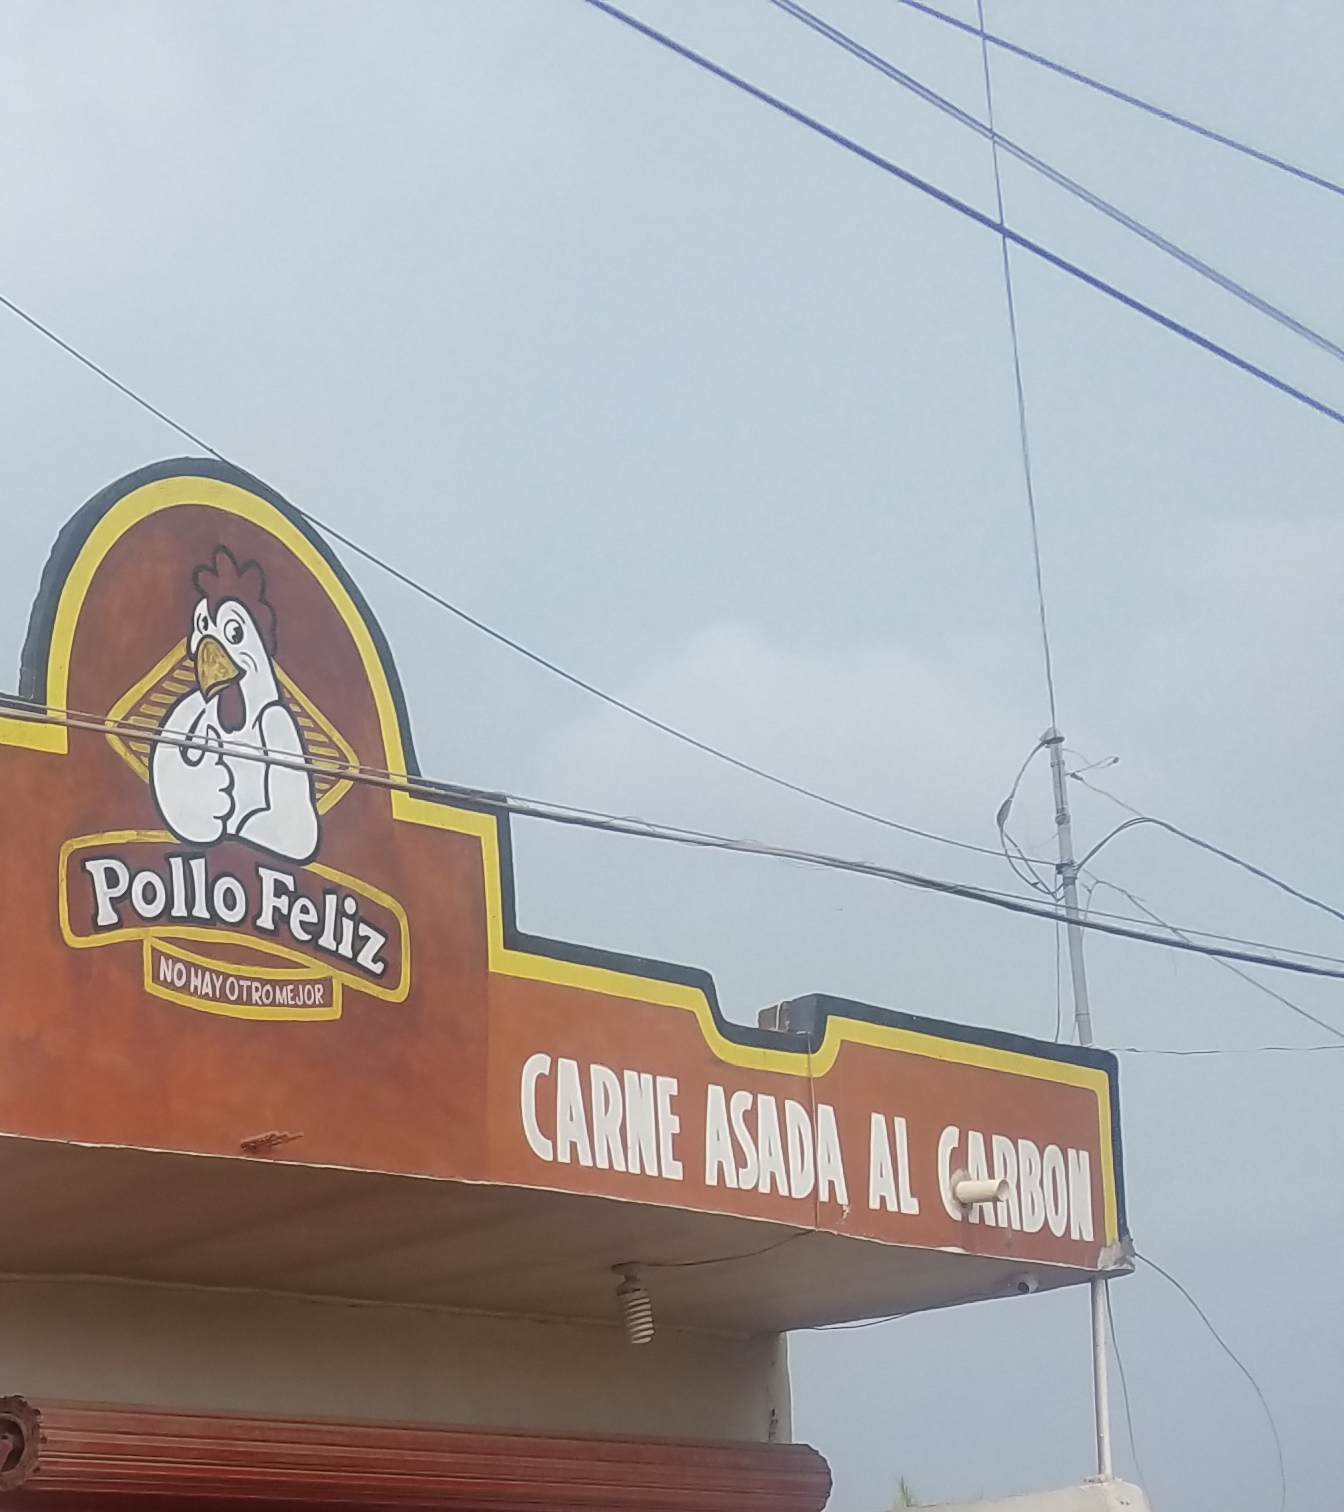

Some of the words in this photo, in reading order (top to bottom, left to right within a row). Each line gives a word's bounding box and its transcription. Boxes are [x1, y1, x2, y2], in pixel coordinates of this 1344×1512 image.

[85, 856, 247, 926] Pollo
[256, 865, 387, 975] Feliz
[158, 955, 187, 988] NO
[189, 966, 224, 999] HAY
[225, 976, 274, 1006] OTRO
[275, 983, 325, 1006] MEJOR
[518, 1051, 684, 1182] CARNE
[704, 1083, 849, 1206] ASADA
[868, 1111, 920, 1216] AL
[937, 1124, 1095, 1242] CARBON
